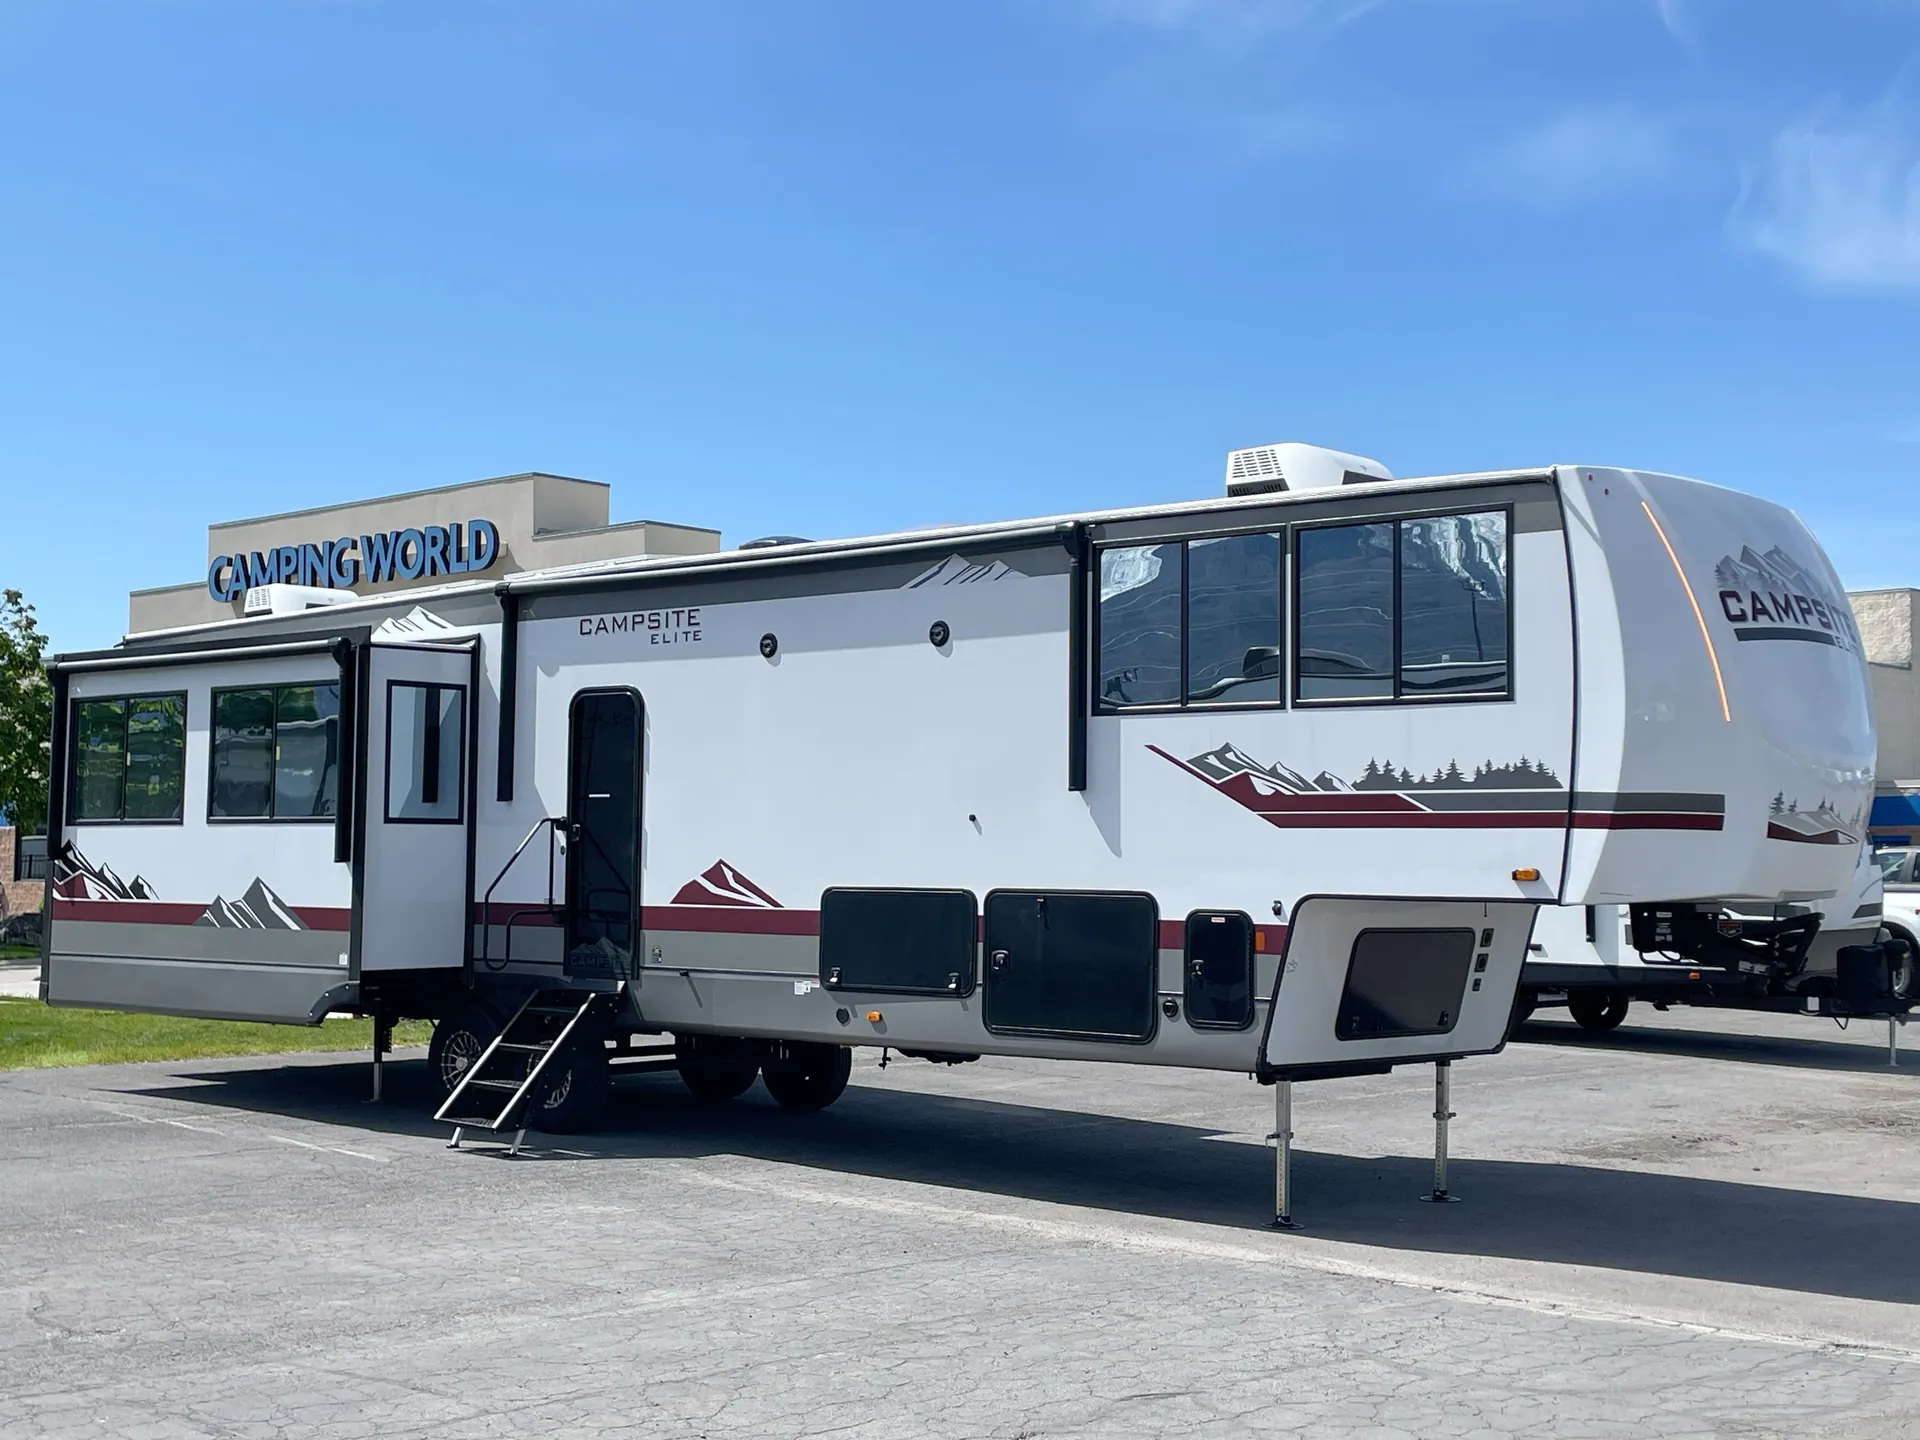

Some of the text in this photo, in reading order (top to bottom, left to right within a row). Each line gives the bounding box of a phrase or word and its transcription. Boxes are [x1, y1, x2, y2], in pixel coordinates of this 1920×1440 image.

[208, 519, 499, 603] CAMPING WORLD
[580, 608, 700, 635] CAMPSITE
[650, 630, 702, 645] ELITE
